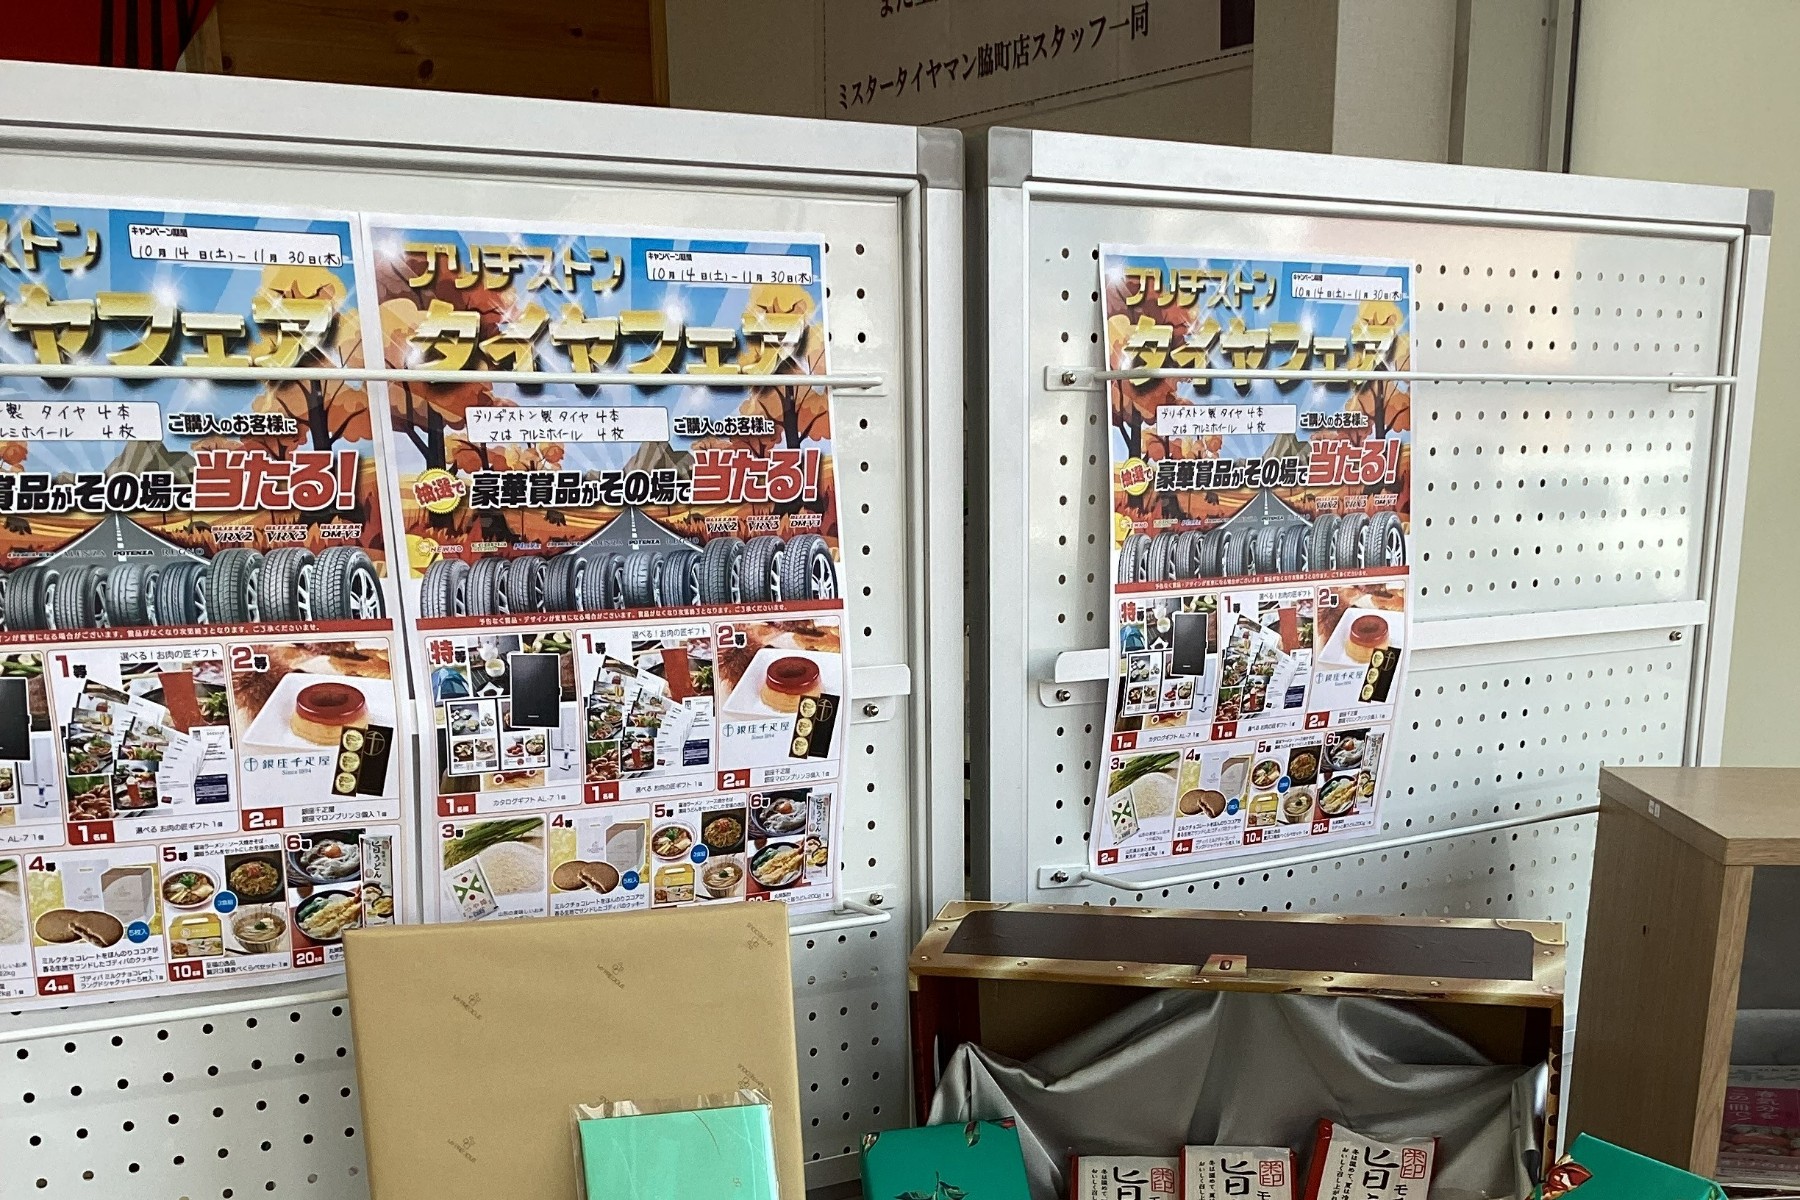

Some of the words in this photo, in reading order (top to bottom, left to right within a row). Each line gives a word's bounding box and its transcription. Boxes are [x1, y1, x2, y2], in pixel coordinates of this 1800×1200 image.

[838, 2, 1150, 110] ミスタータイヤマン脇町店スタッフ一同
[0, 284, 334, 369] ヤフェア
[404, 299, 812, 388] タイヤフェア
[1124, 315, 1398, 387] タイヤフェア
[168, 413, 298, 435] ご購入のお客様に
[673, 415, 775, 436] ご購入のお客様に
[1299, 412, 1368, 429] ご購入のお客様に
[213, 531, 254, 543] VRX2
[266, 530, 308, 542] VRX3
[321, 530, 362, 539] DM-V3
